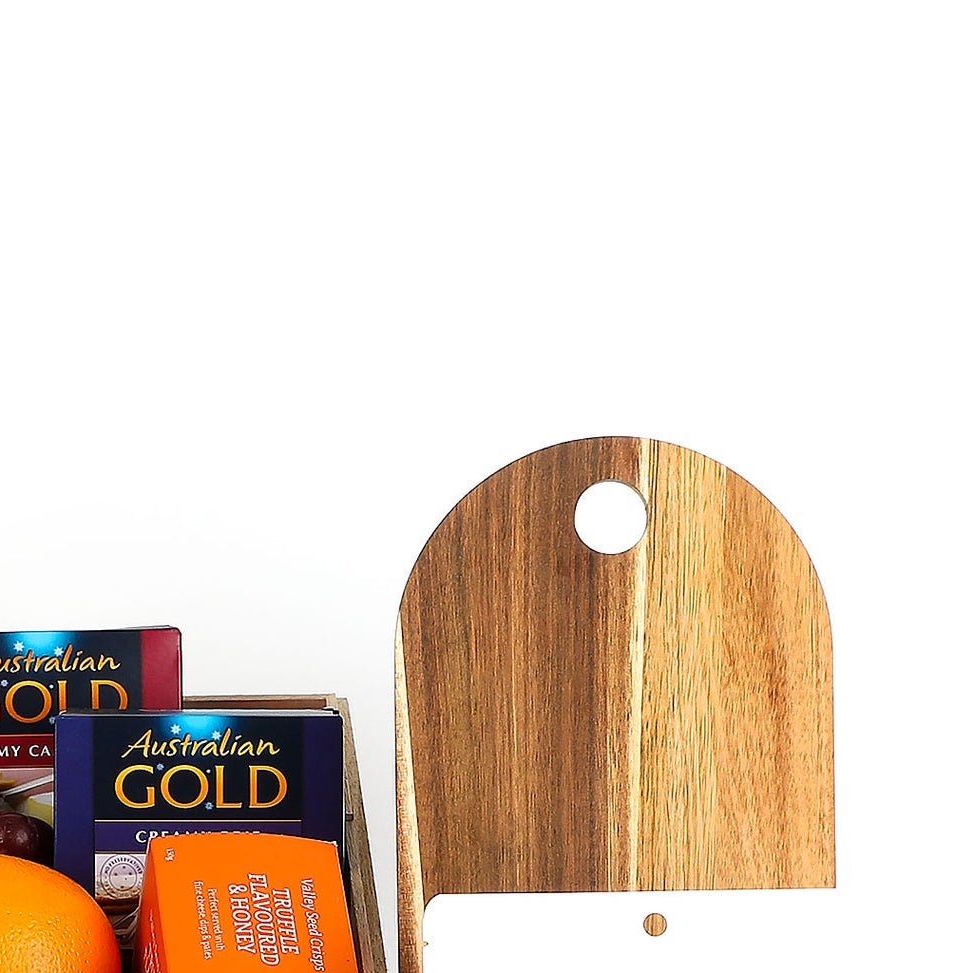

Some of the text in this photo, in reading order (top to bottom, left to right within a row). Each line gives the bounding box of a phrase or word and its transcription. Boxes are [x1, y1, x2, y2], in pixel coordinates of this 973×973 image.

[121, 728, 280, 758] Australian
[114, 764, 288, 809] GOLD
[194, 881, 204, 895] fine
[207, 888, 226, 951] Perfect served with
[228, 884, 256, 954] & HONEY
[248, 873, 280, 966] FLAVOURED
[198, 919, 210, 935] dips
[272, 888, 300, 955] TRUFFLE
[301, 879, 326, 971] Valley Seed Crisps
